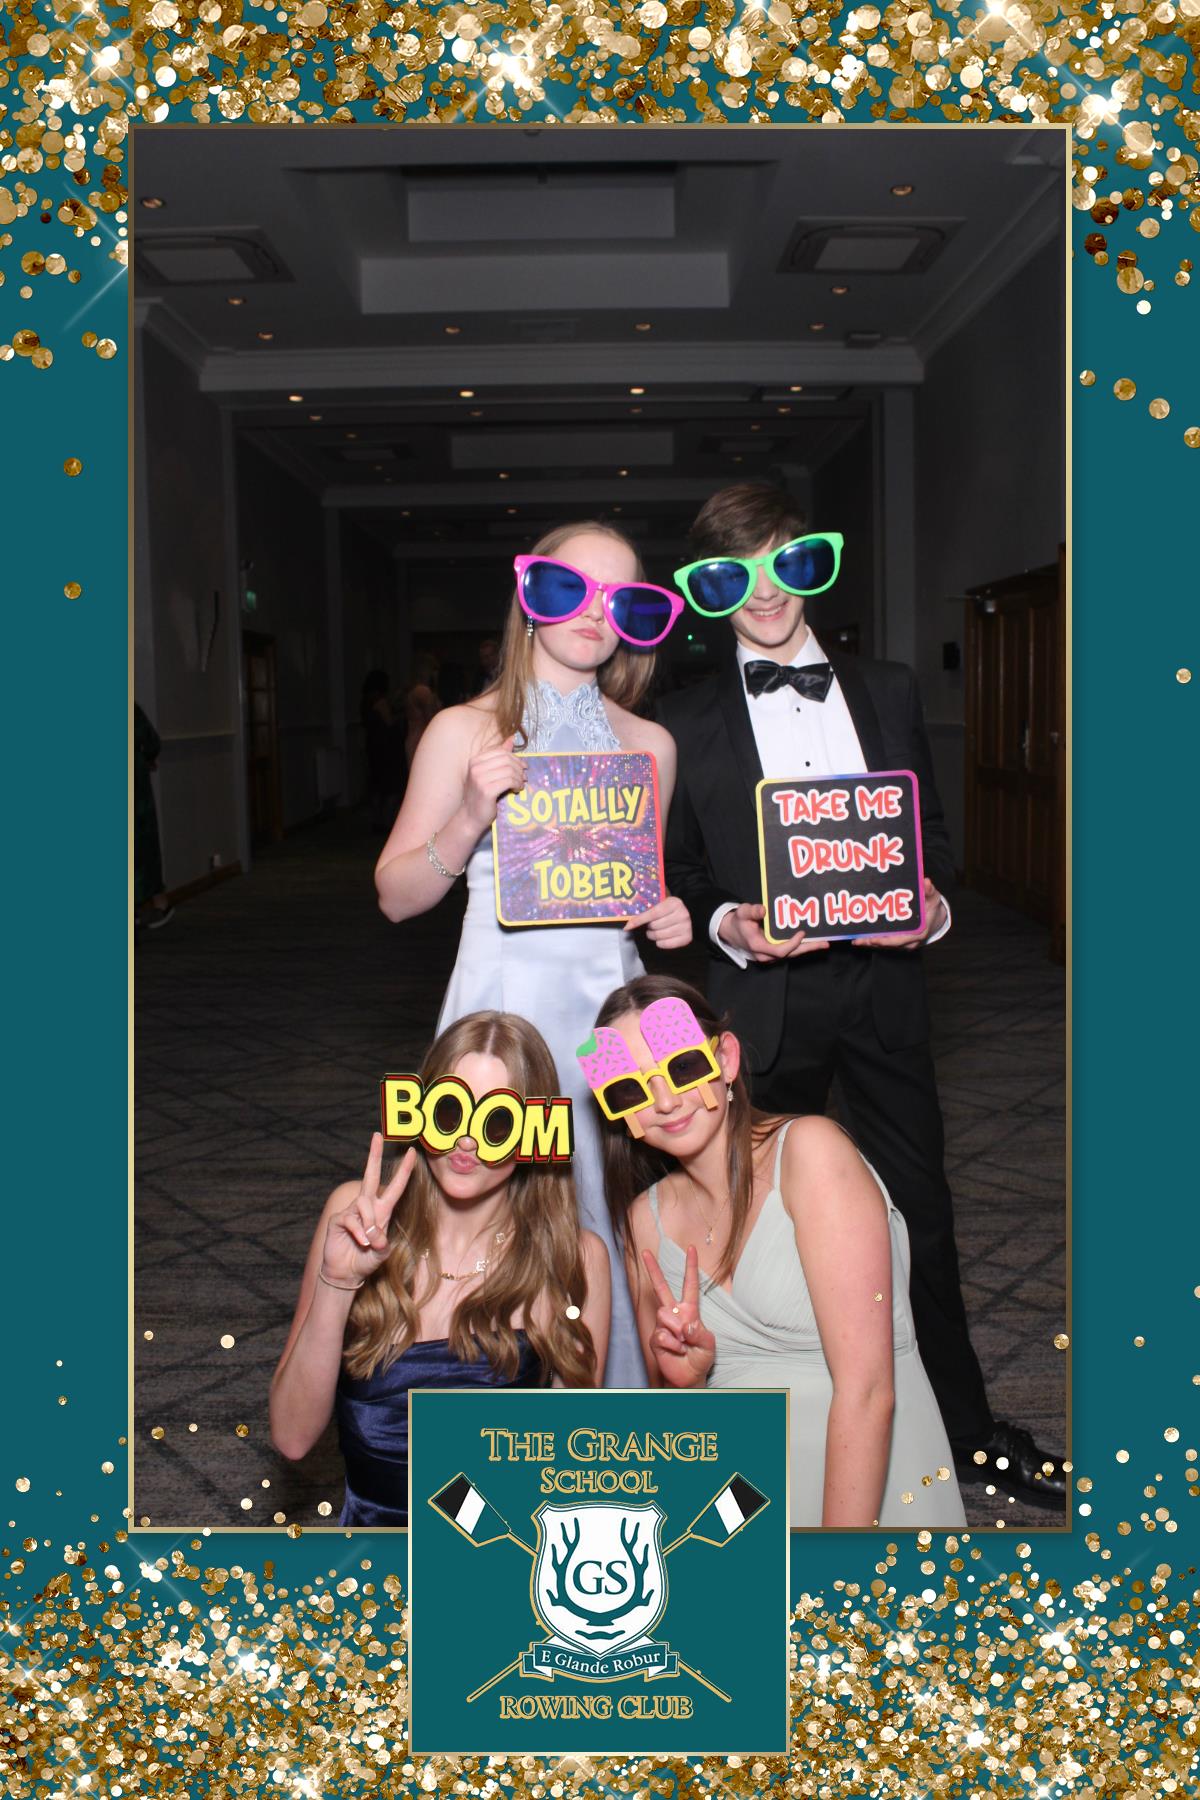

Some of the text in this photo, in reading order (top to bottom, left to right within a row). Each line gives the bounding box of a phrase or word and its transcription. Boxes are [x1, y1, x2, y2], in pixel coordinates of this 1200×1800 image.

[507, 785, 642, 826] SOTALLY
[772, 786, 903, 826] TAKE ME
[788, 833, 904, 878] DRUNK
[534, 859, 634, 900] TOBER
[775, 889, 913, 929] I'M HOME
[380, 1073, 575, 1167] BOOM
